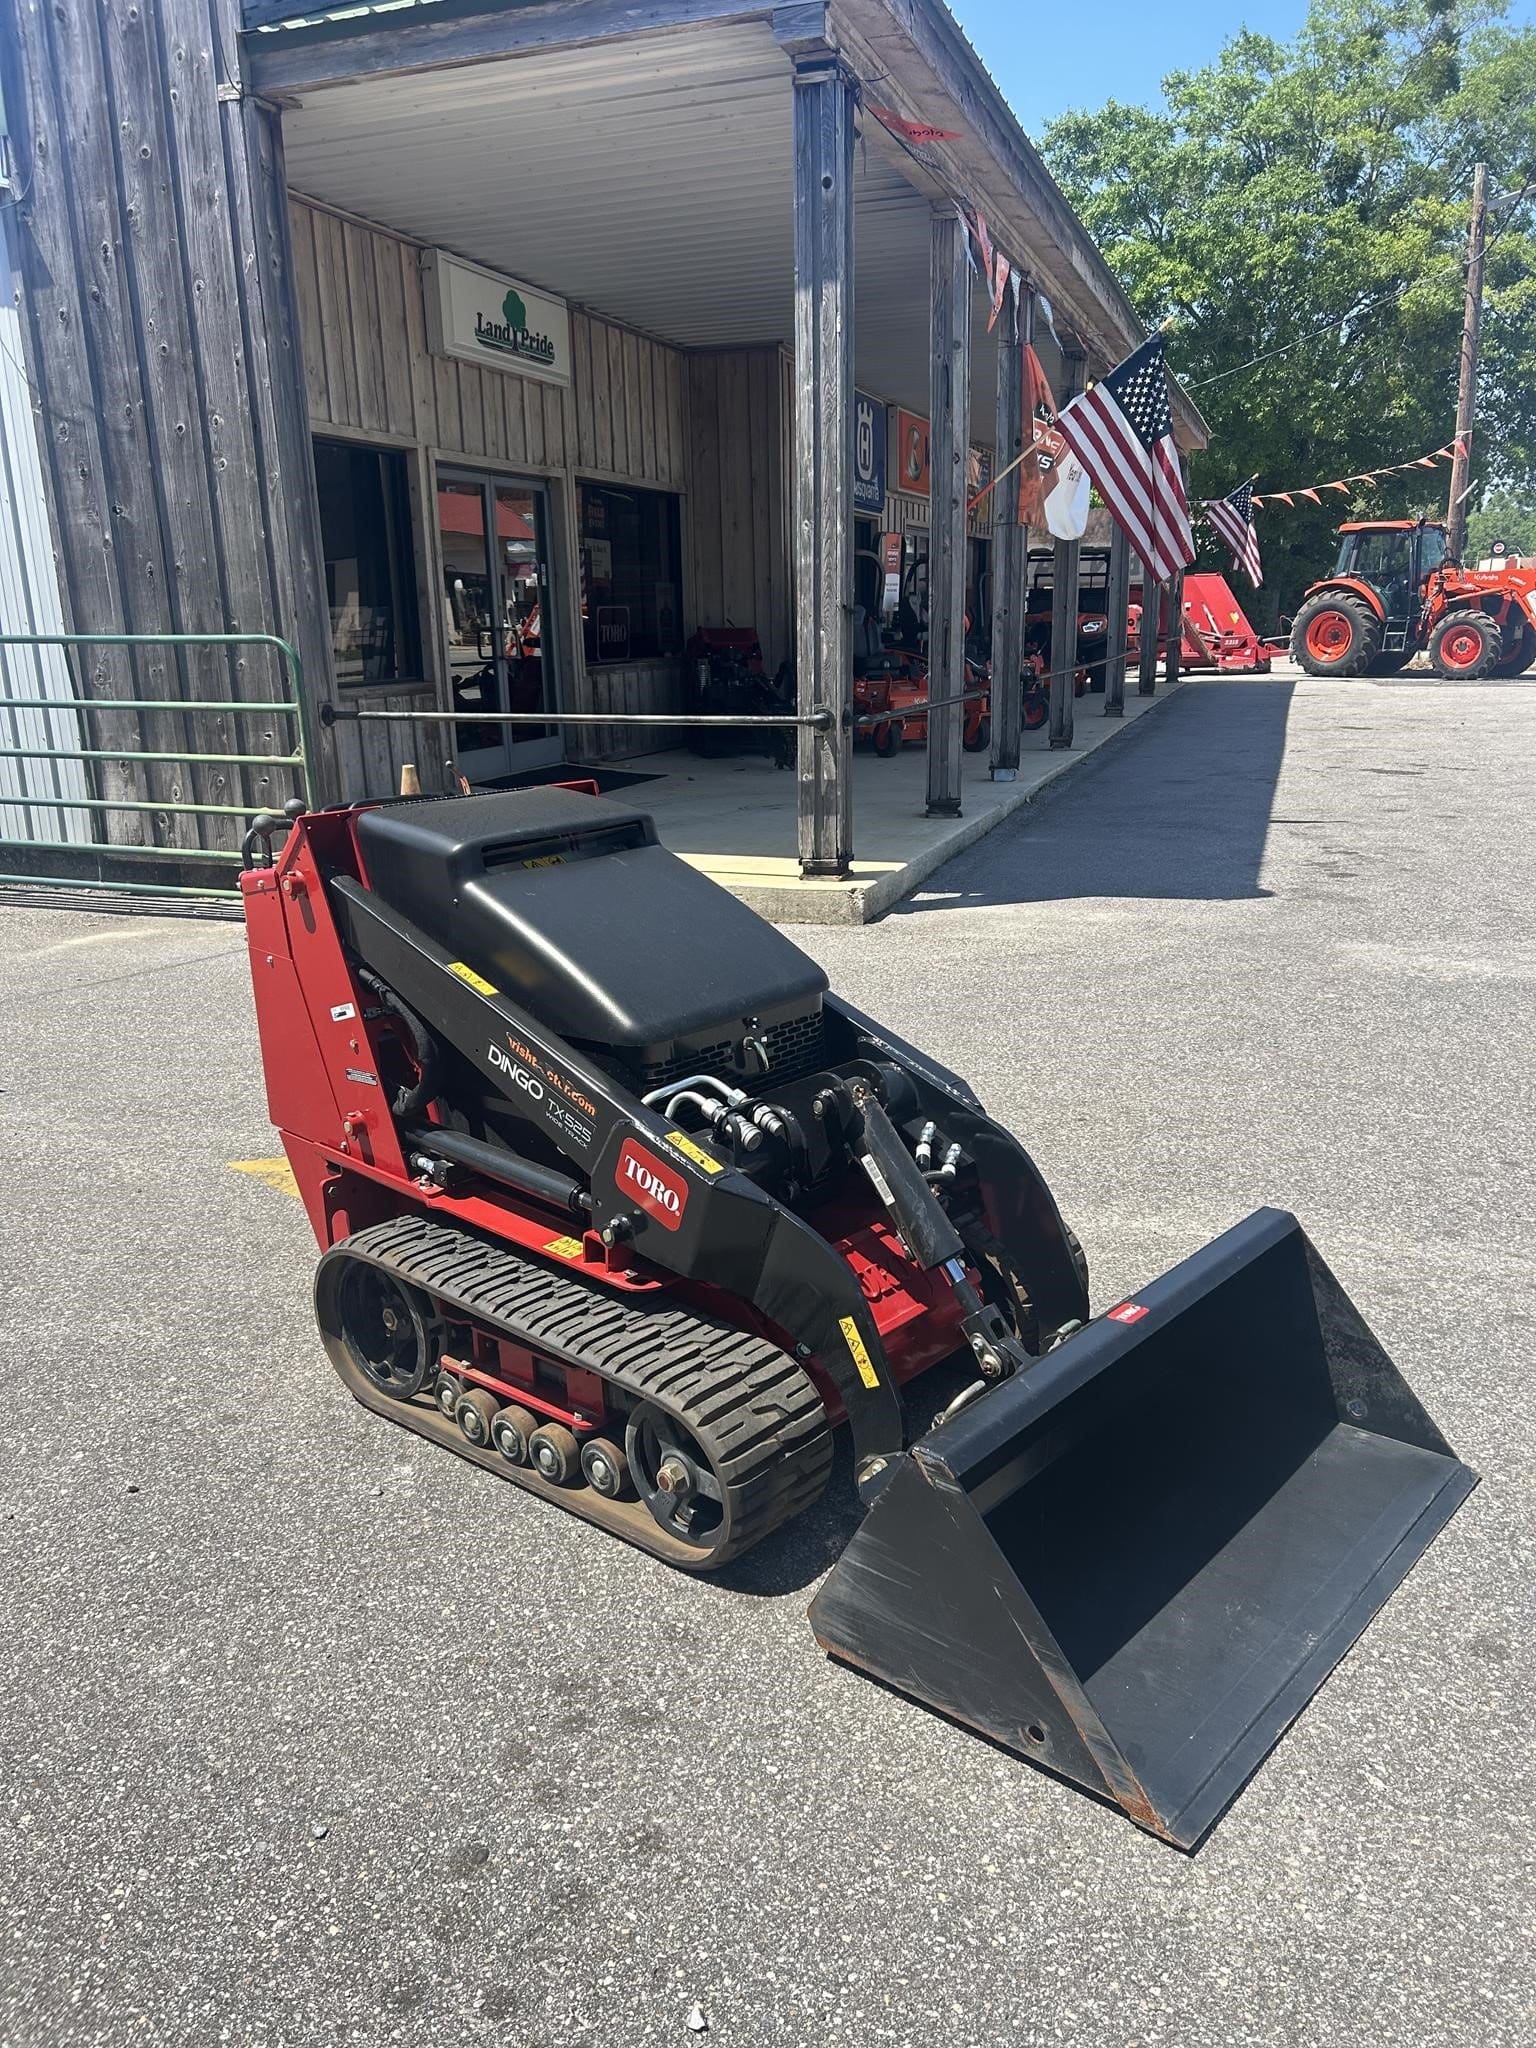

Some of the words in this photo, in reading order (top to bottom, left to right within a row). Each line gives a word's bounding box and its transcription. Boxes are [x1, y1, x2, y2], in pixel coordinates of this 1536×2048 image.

[476, 311, 511, 342] Land
[521, 327, 554, 356] Pride
[600, 624, 627, 643] TORO
[487, 1044, 544, 1101] DINGO
[545, 1111, 564, 1129] WIDE
[564, 1126, 589, 1150] TRACK
[624, 1154, 680, 1212] TORO
